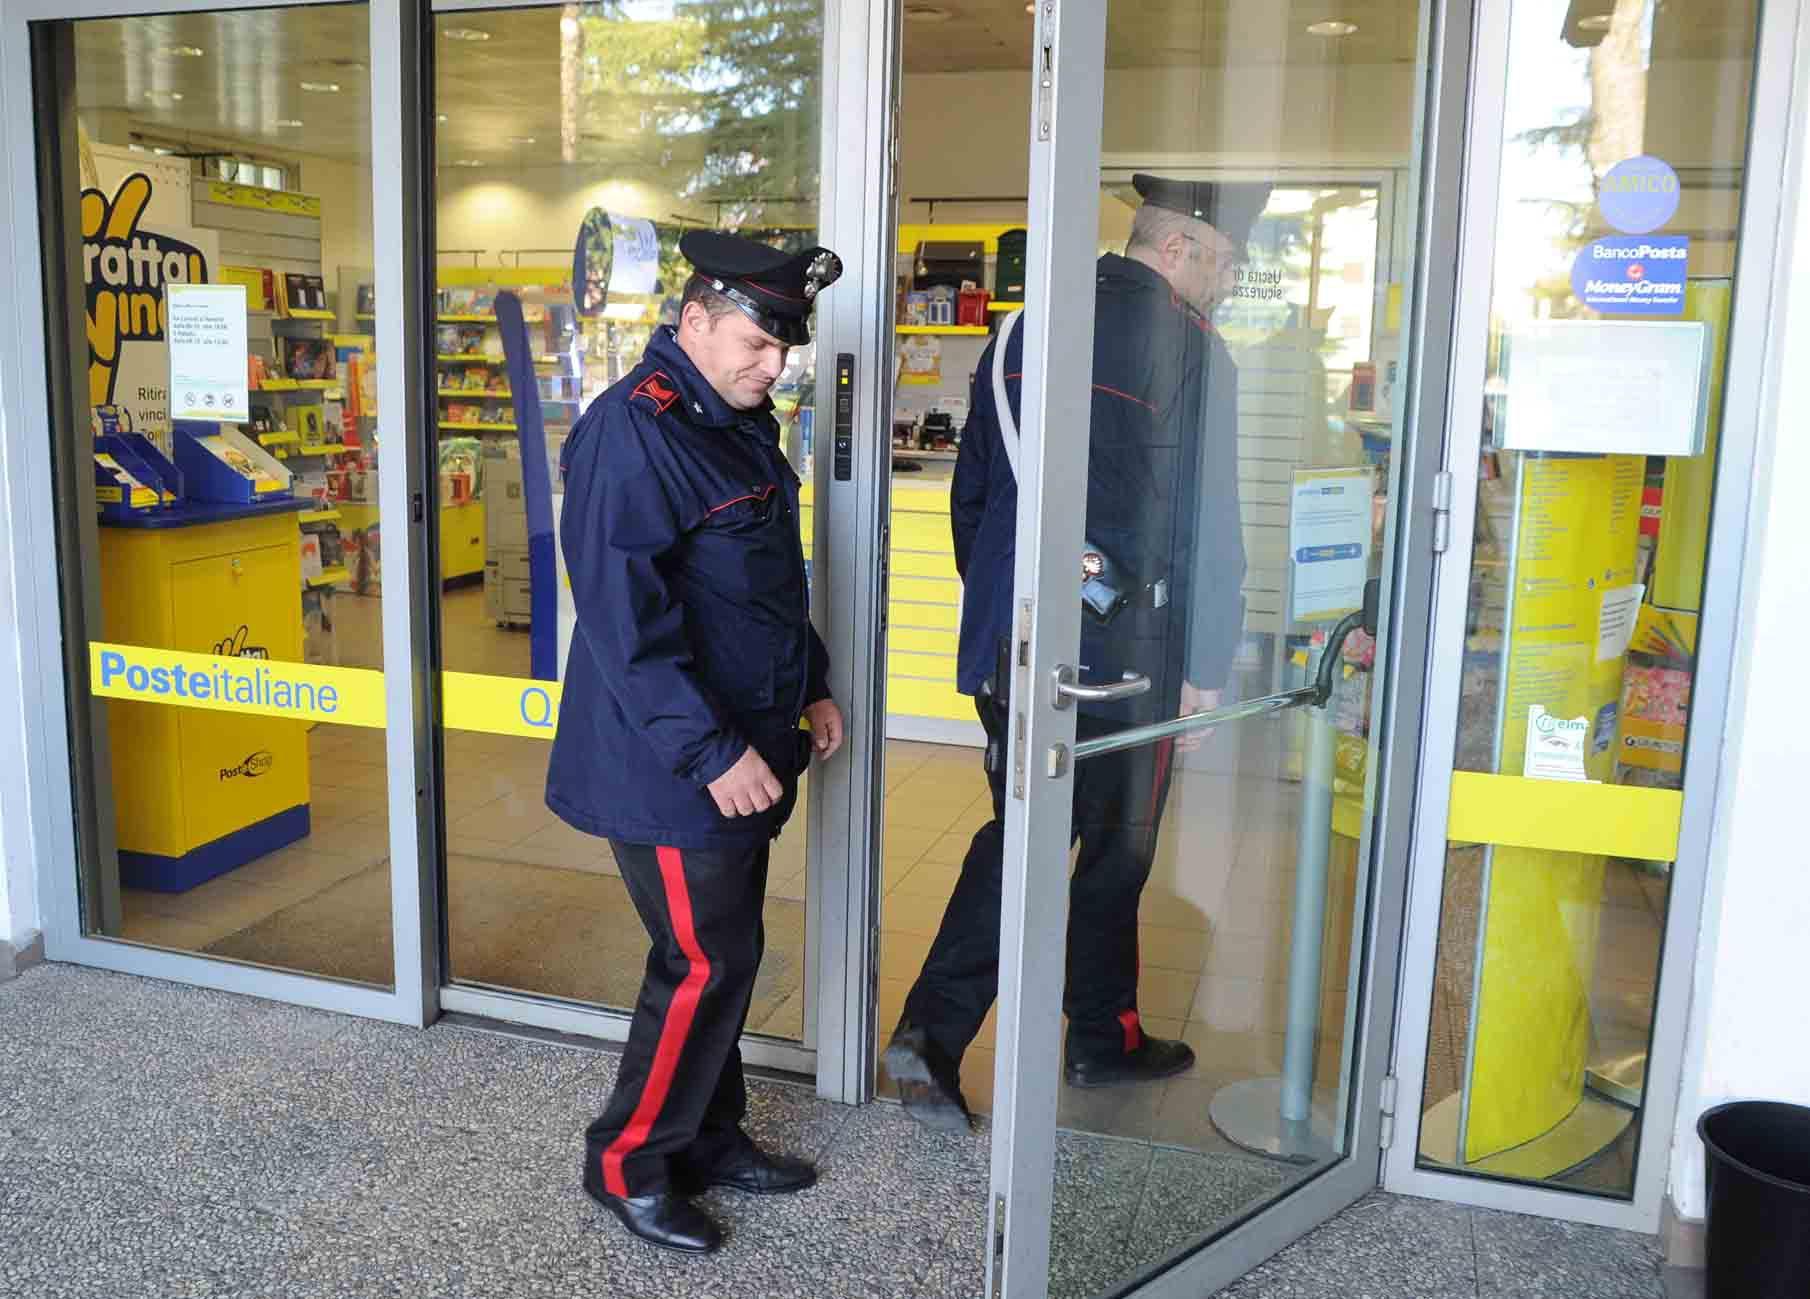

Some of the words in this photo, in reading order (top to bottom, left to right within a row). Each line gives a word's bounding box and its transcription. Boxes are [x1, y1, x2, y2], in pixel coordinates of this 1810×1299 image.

[1593, 244, 1688, 260] BancoPosta
[1584, 279, 1681, 297] MoneyGram
[100, 651, 338, 713] Posteitaliane
[520, 687, 554, 728] Q
